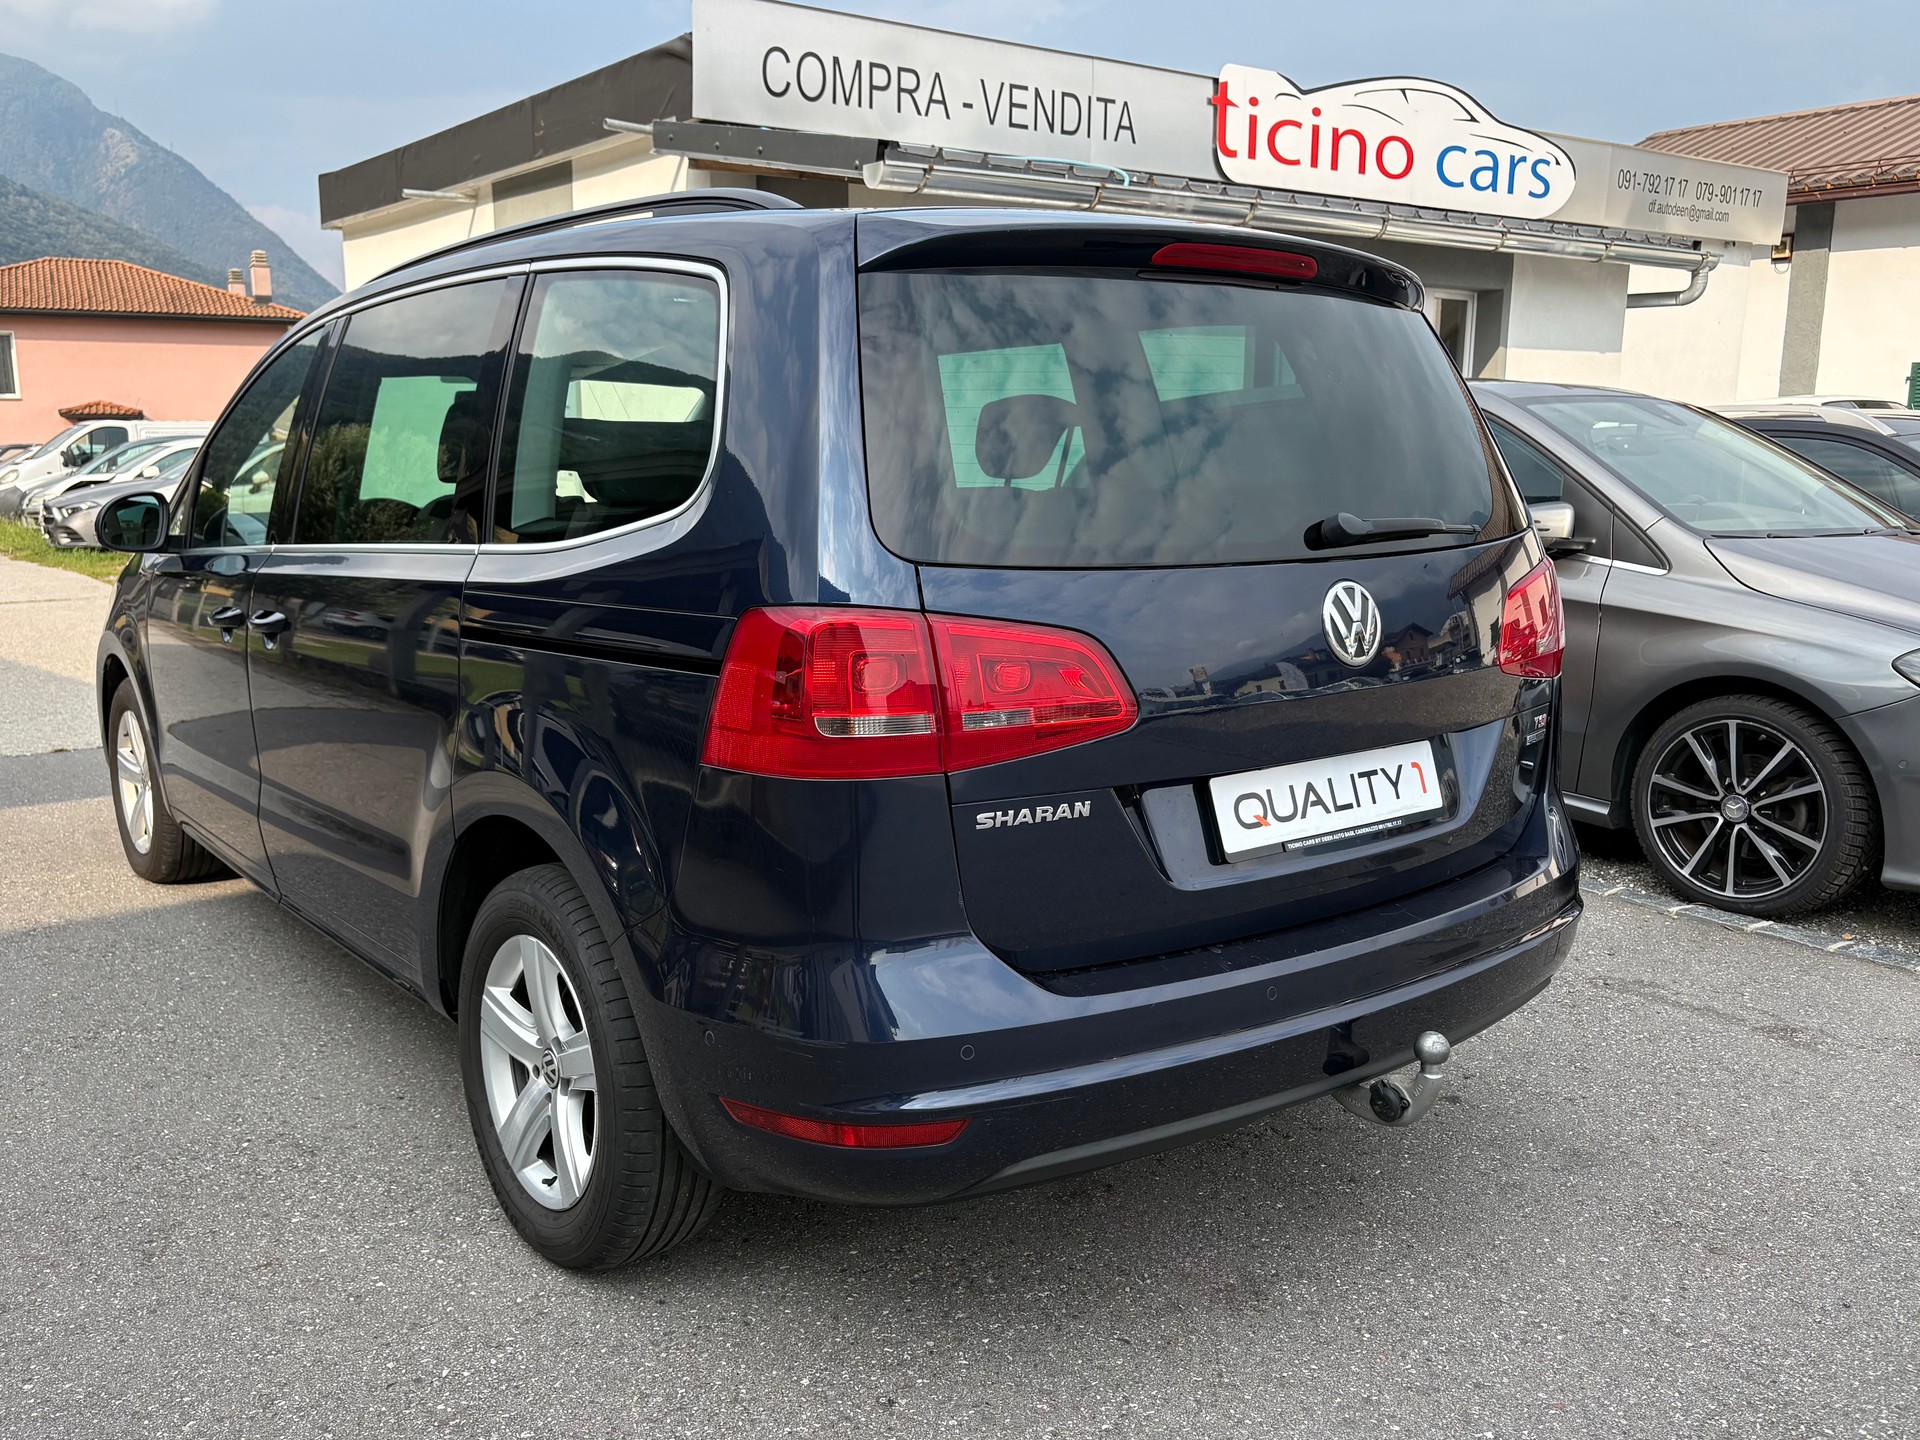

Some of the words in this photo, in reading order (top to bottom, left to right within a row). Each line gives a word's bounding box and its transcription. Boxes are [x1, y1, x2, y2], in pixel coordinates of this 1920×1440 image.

[761, 46, 951, 121] COMPRA
[1211, 81, 1414, 180] ticino
[1436, 145, 1551, 199] cars
[1617, 169, 1662, 194] 091-792
[1648, 199, 1730, 223] df.autodeen@gmail.com
[975, 800, 1091, 830] SHARAN
